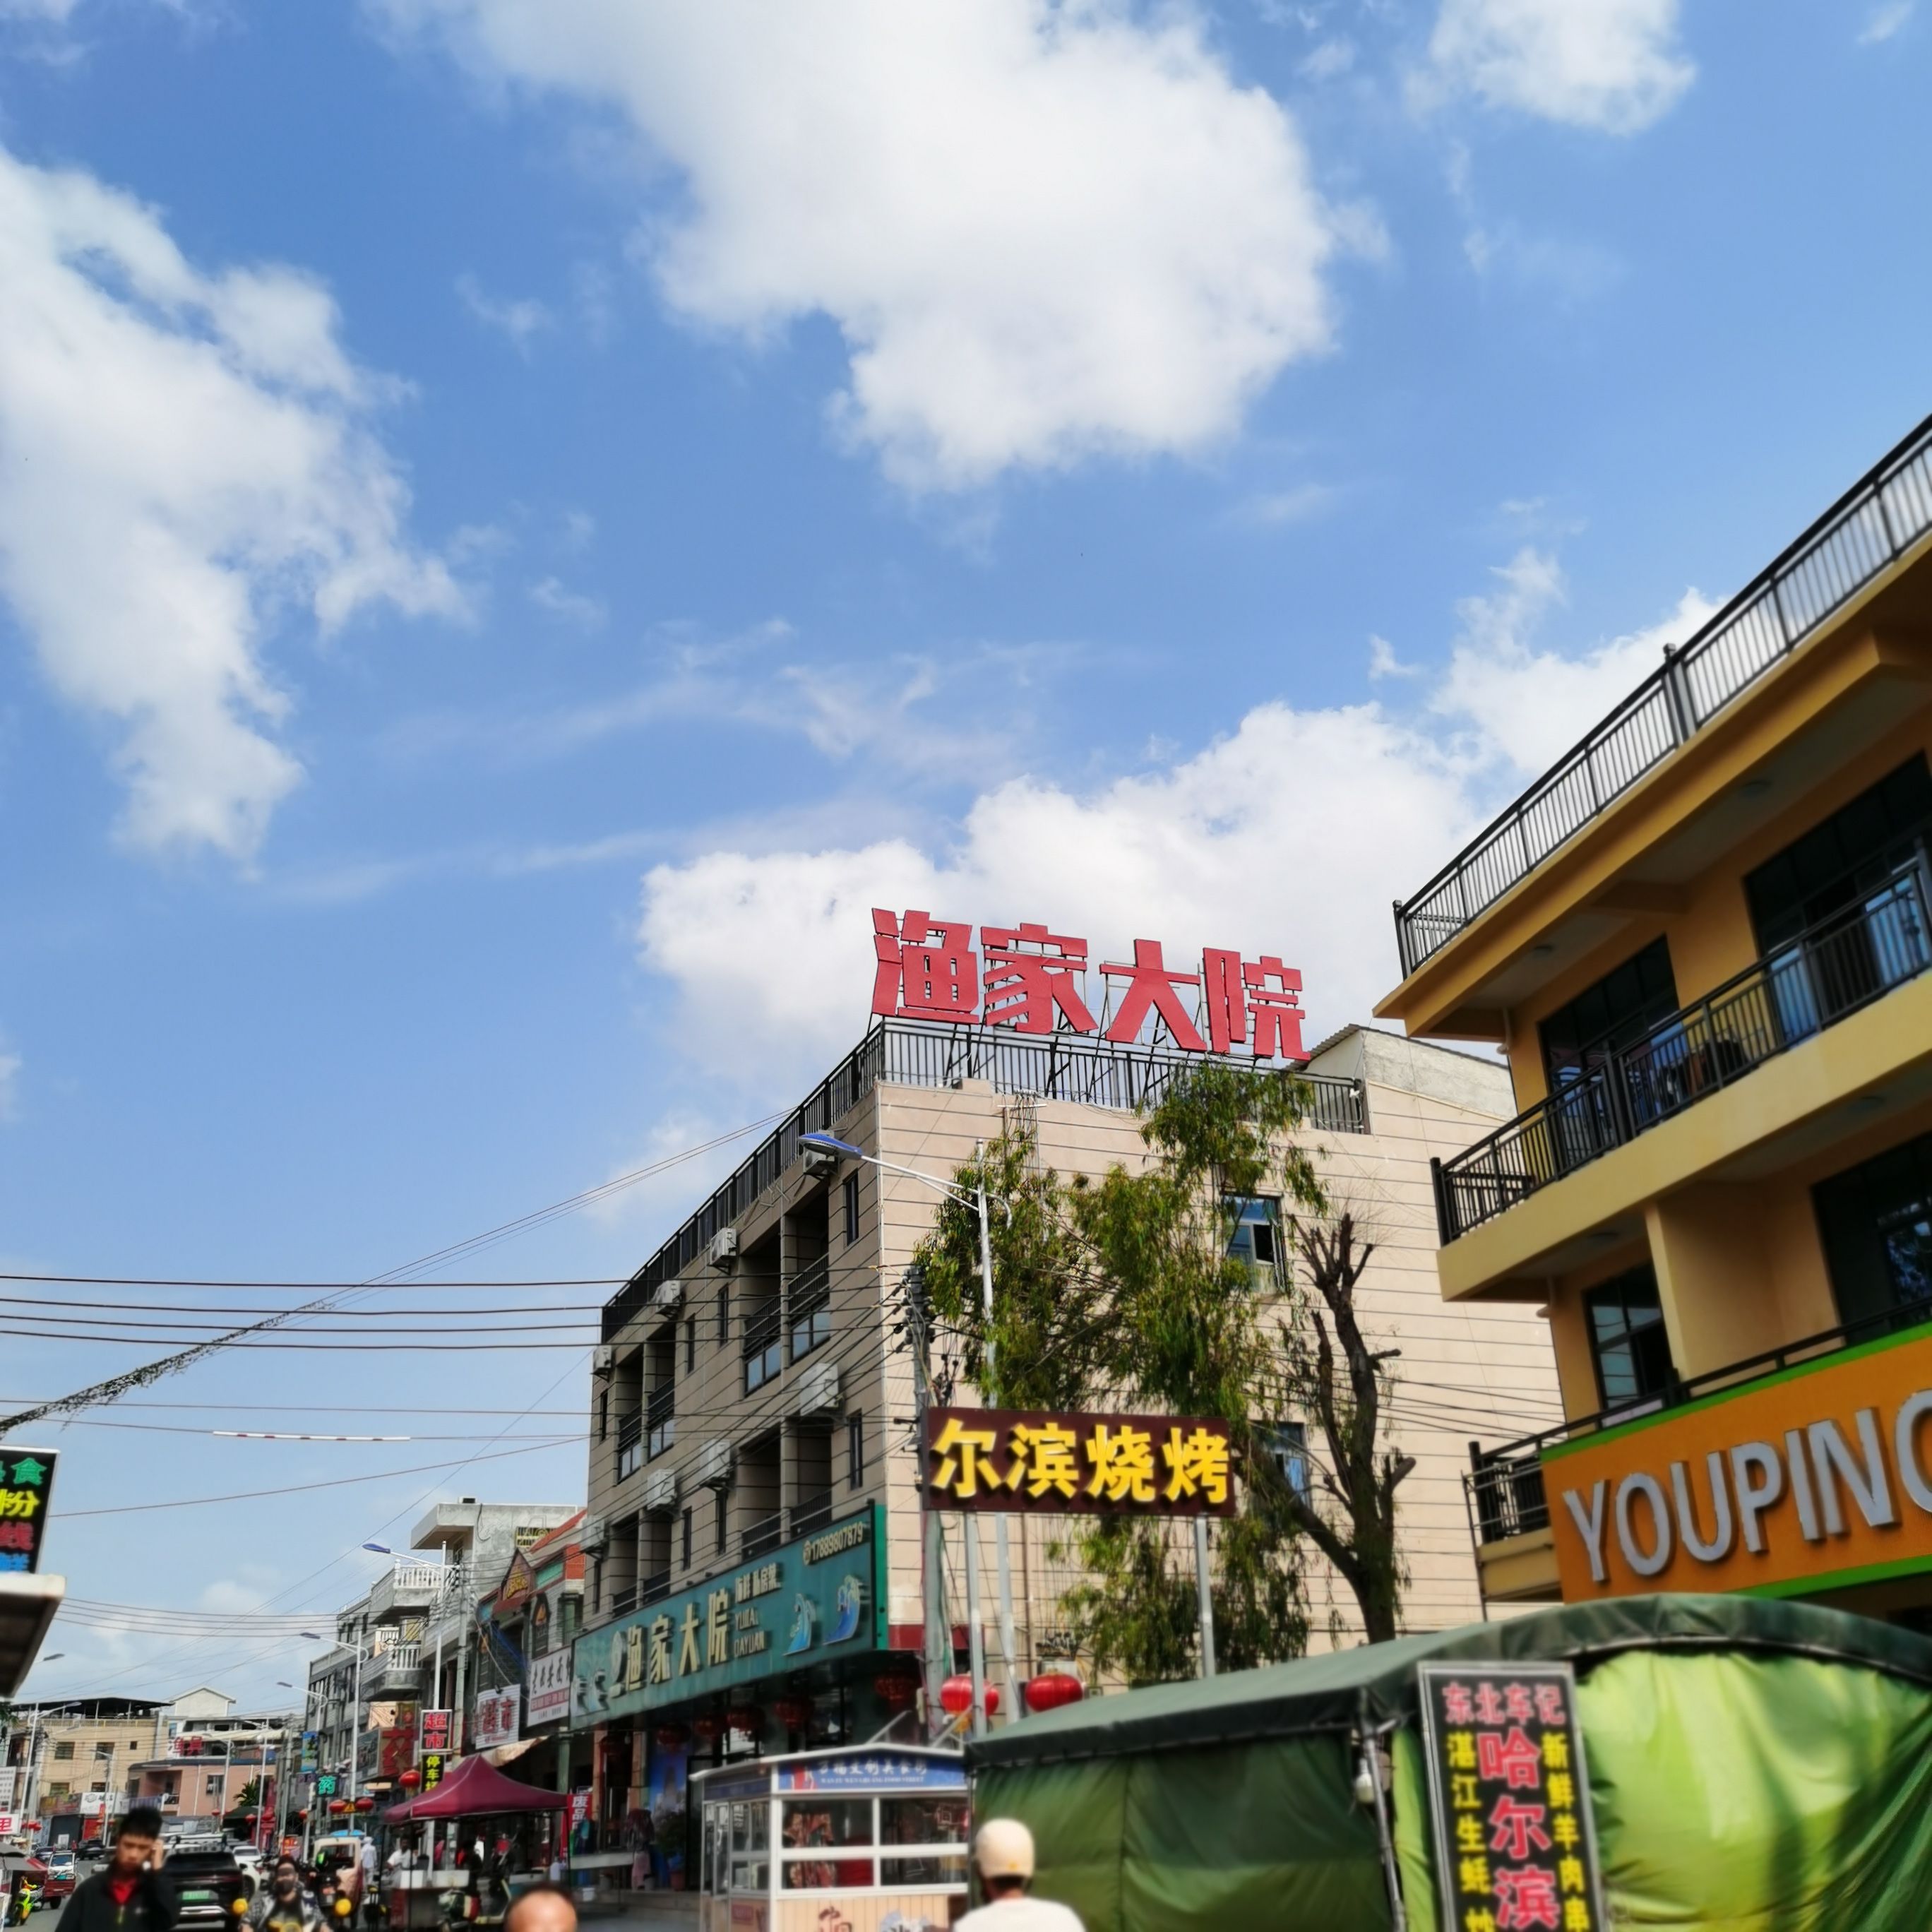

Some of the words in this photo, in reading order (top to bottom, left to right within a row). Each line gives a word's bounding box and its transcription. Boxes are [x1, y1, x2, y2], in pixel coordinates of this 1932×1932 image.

[872, 908, 1311, 1060] 渔家大院
[0, 1457, 47, 1485] 食
[931, 1418, 1230, 1503] 尔滨烧烤
[626, 1587, 729, 1691] 渔家大院
[734, 1630, 765, 1657] DAYUAN
[424, 1713, 447, 1748] 超市
[318, 1776, 335, 1795] 药
[1477, 1727, 1560, 1929] 哈尔滨
